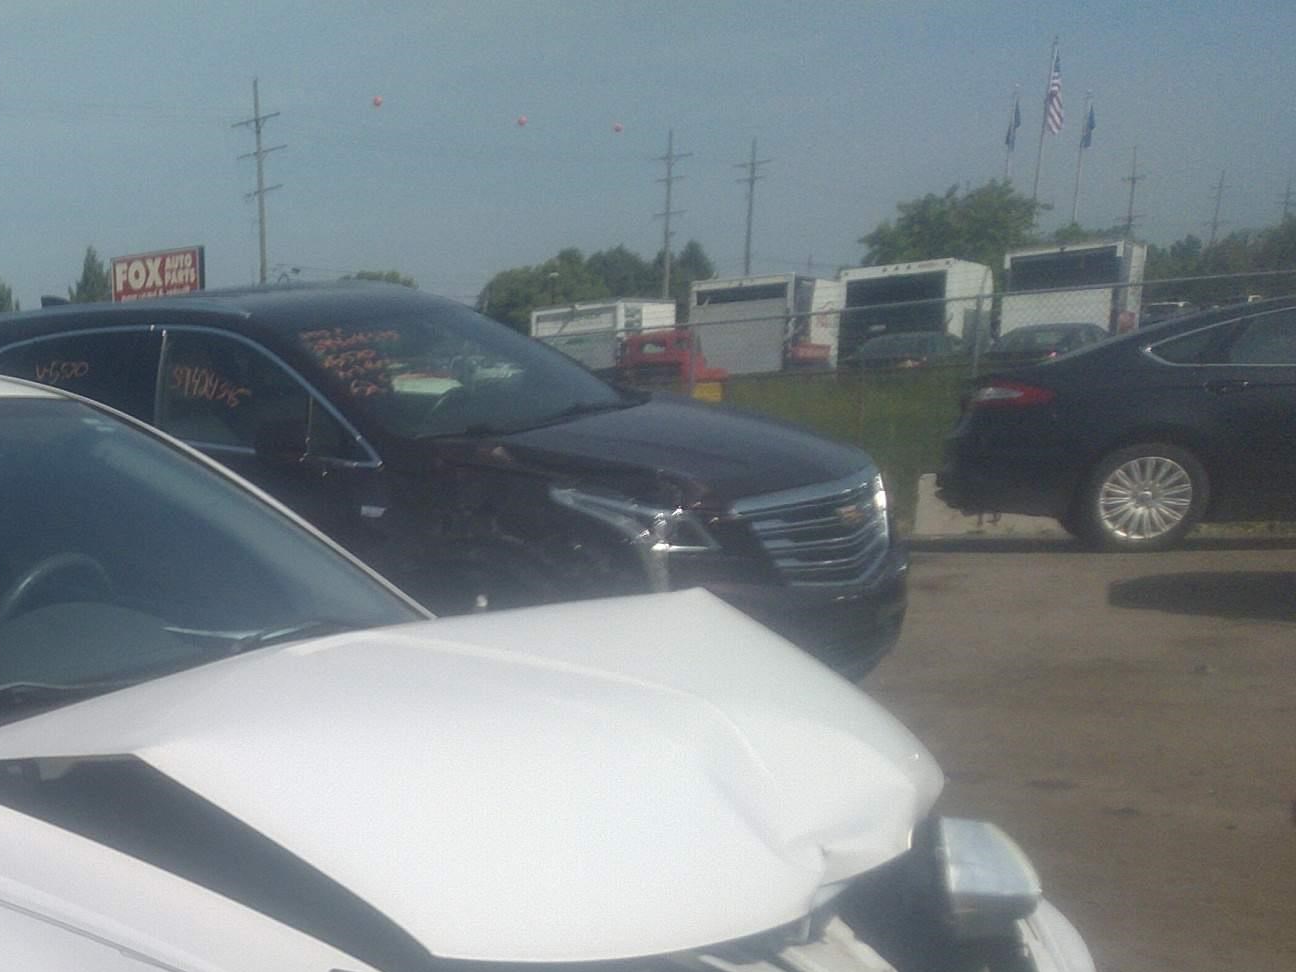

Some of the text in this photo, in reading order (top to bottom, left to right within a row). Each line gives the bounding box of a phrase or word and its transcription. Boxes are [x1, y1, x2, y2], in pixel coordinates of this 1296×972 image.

[165, 253, 193, 270] AUTO
[114, 257, 163, 293] FOX
[164, 267, 196, 287] PARTS
